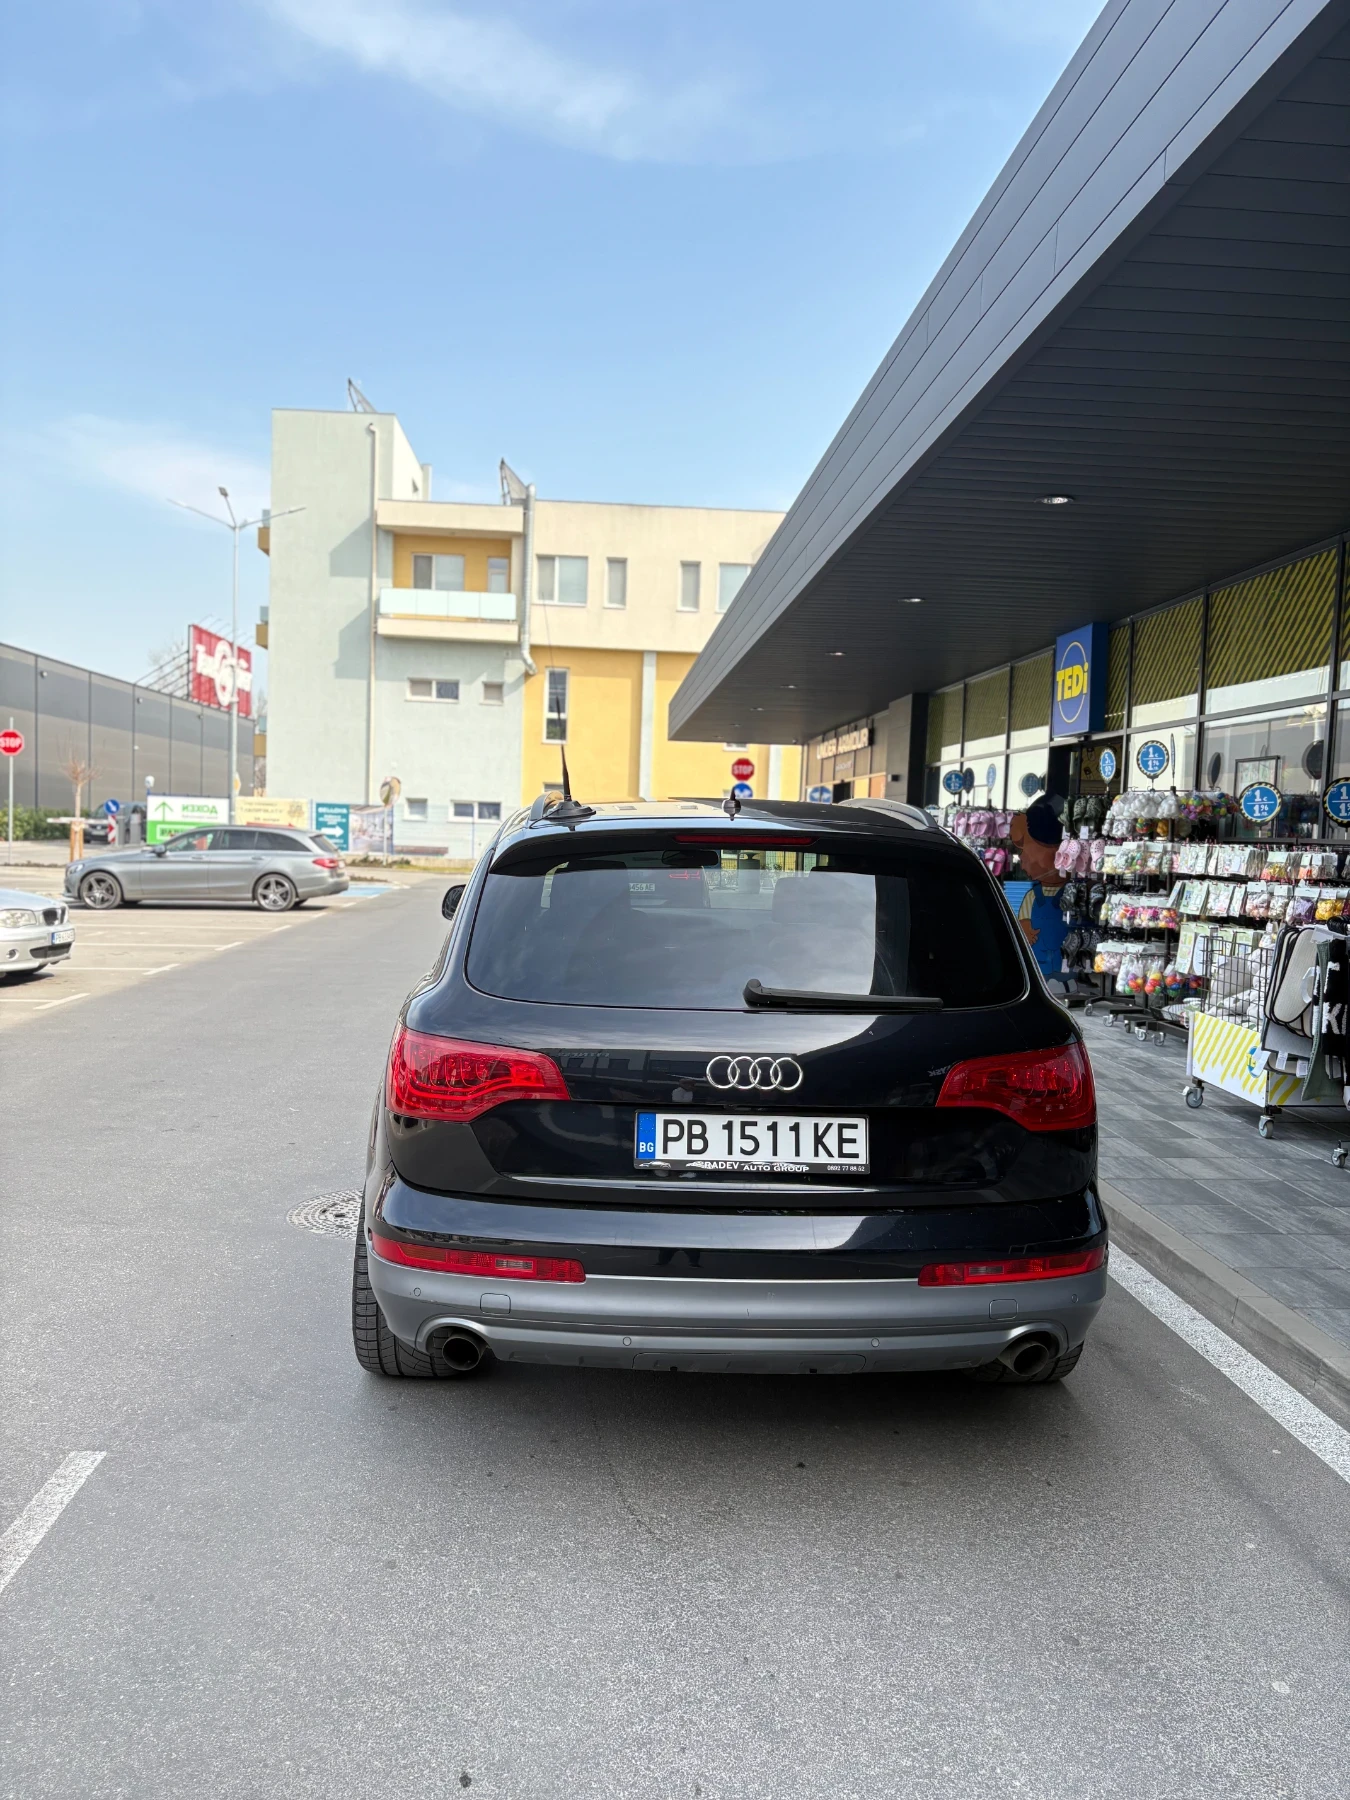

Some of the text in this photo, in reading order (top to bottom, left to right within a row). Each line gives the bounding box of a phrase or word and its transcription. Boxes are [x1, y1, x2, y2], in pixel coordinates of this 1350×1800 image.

[1056, 662, 1089, 702] TEDi
[0, 736, 22, 748] STOP
[816, 728, 869, 760] UNDER ARMOUR
[1148, 747, 1154, 757] 1
[733, 765, 753, 775] STOP
[1254, 789, 1262, 802] 1
[1340, 786, 1349, 800] 1
[662, 1118, 860, 1159] PB 1511 KE
[639, 1142, 654, 1153] BG
[773, 1165, 810, 1173] GROUP
